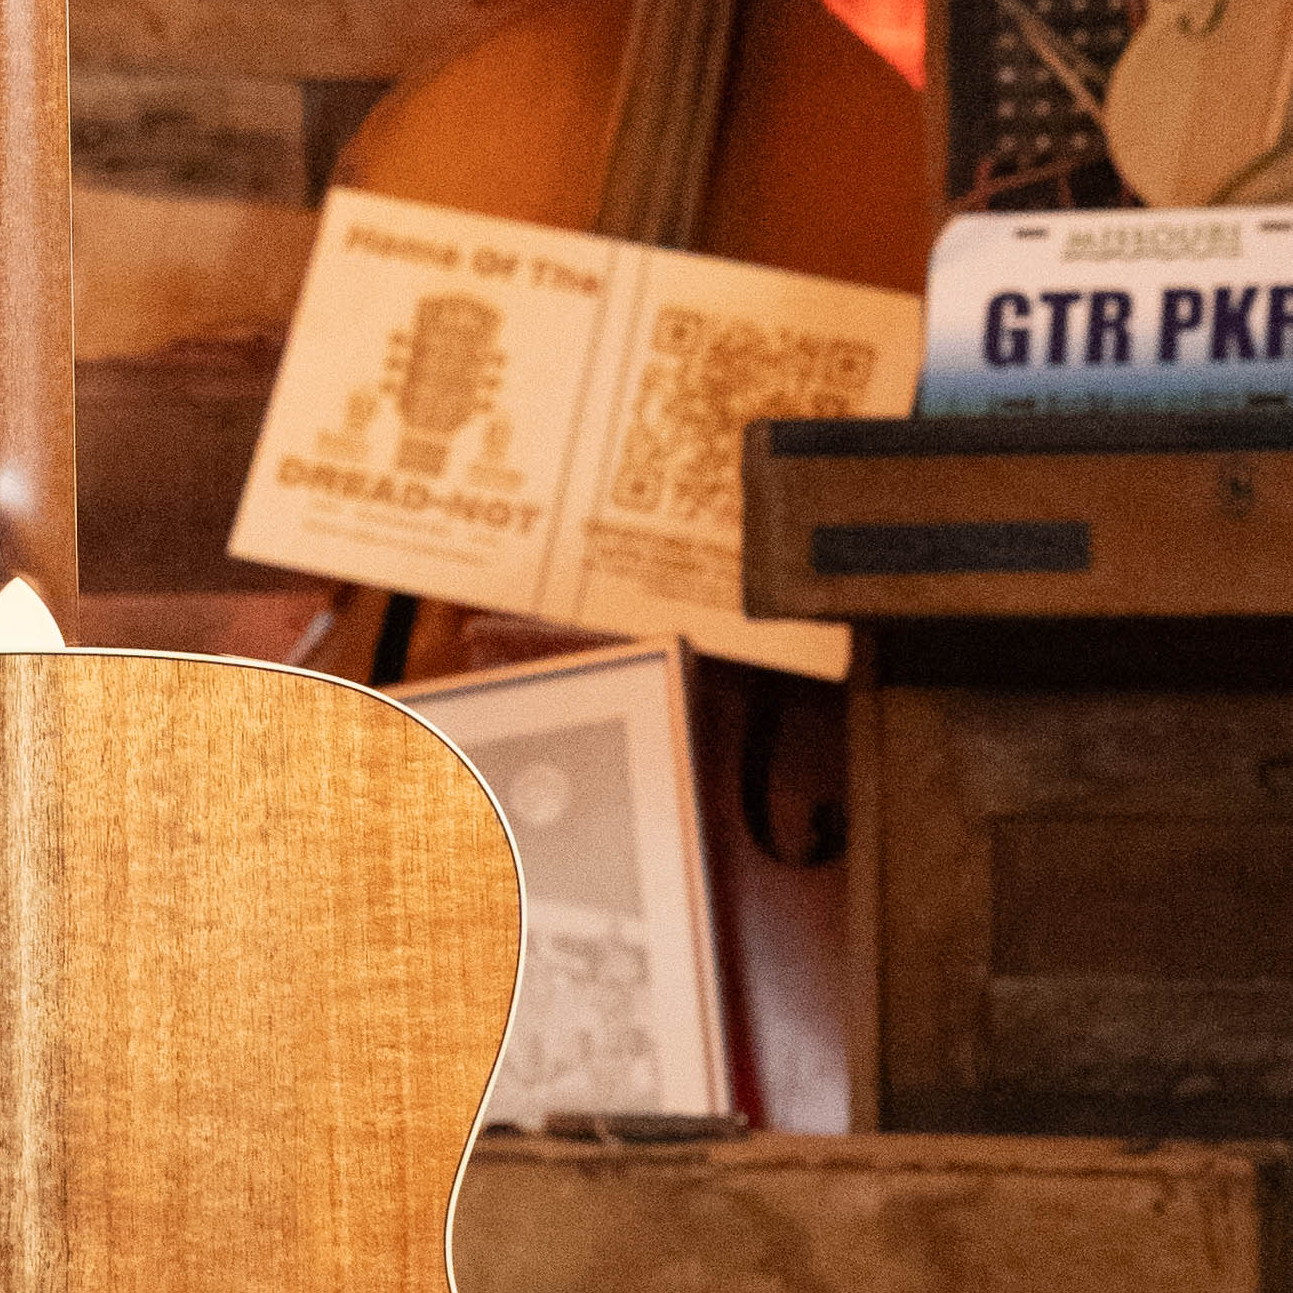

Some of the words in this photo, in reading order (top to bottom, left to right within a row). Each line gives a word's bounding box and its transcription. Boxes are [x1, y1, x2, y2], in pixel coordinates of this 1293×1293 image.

[344, 223, 462, 271] Home
[470, 245, 521, 284] Of
[531, 257, 607, 299] The
[985, 289, 1135, 368] GTR
[275, 453, 543, 538] DREAD-NOT
